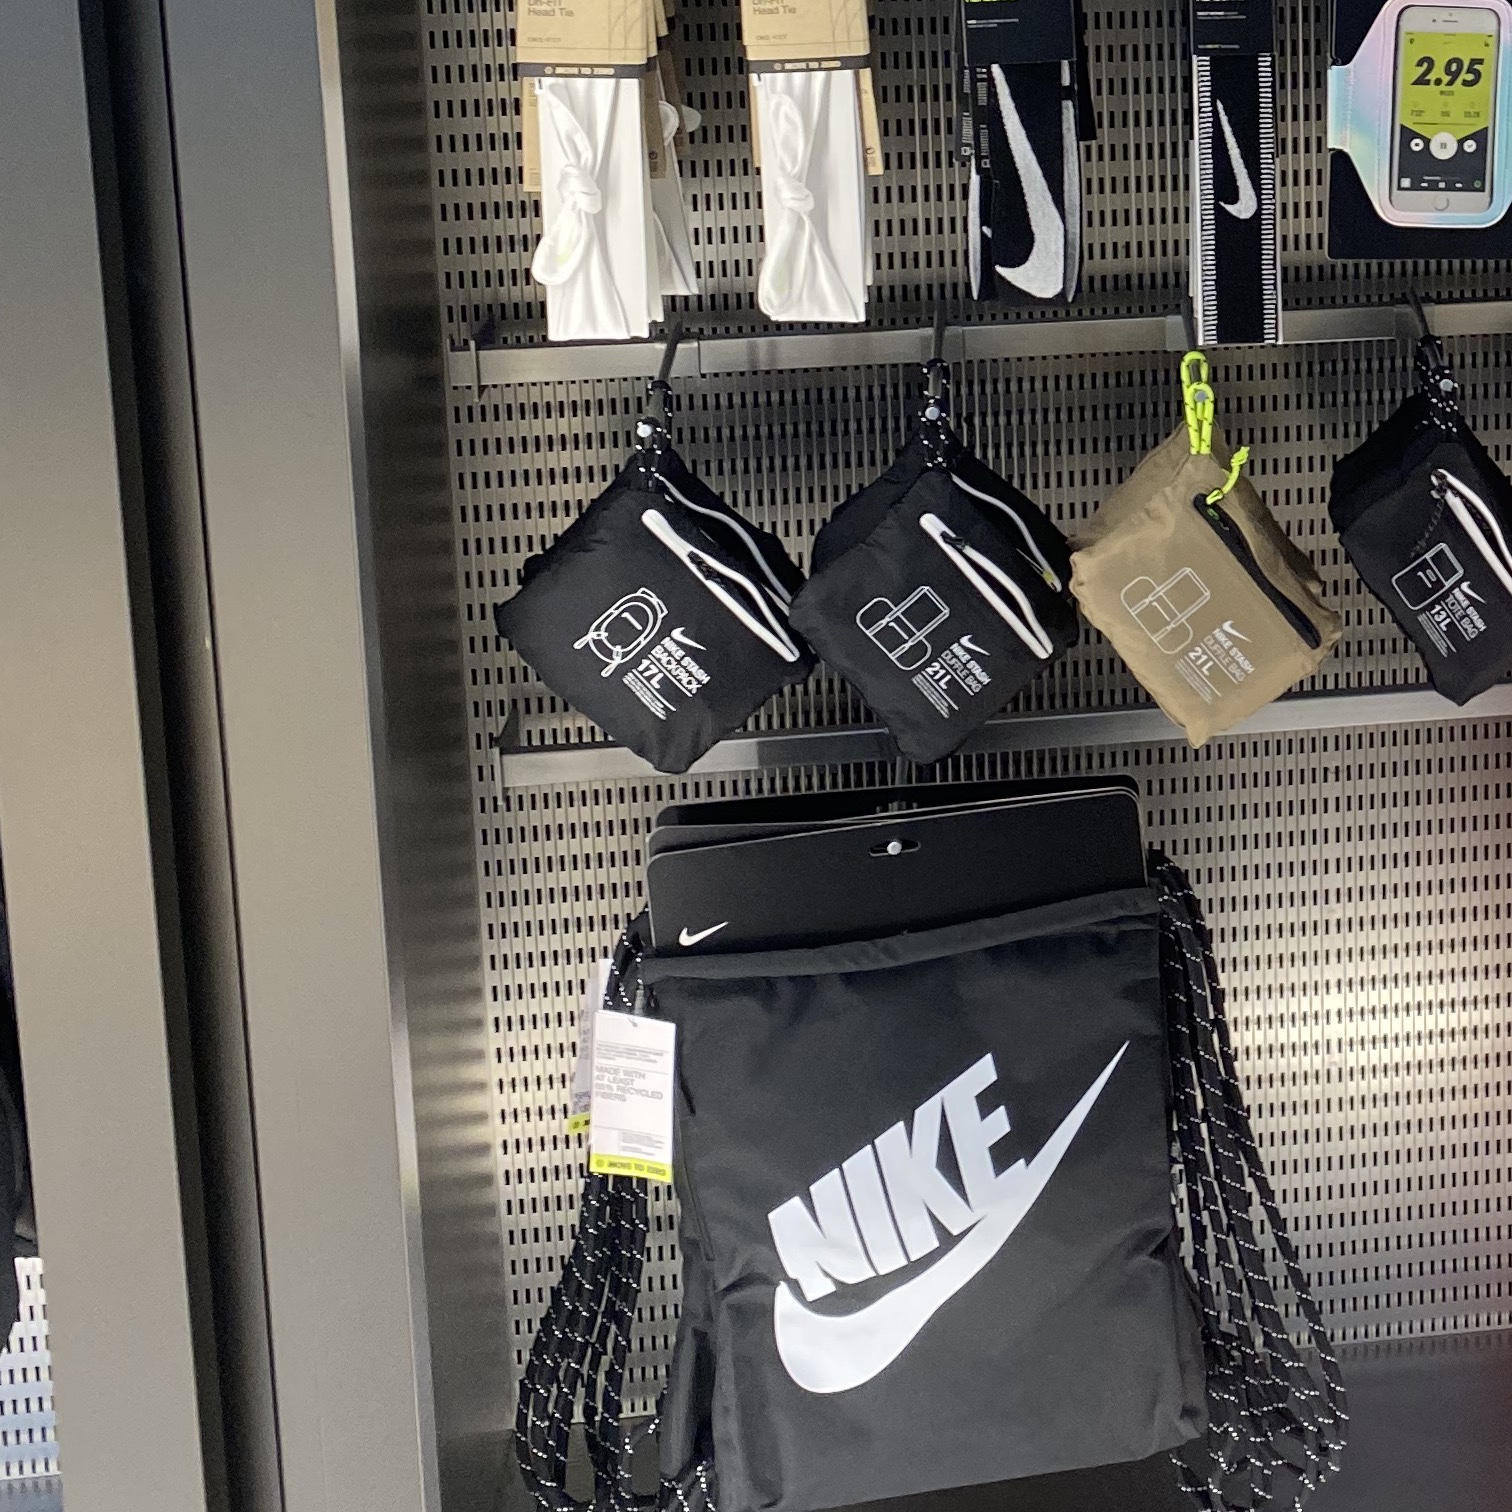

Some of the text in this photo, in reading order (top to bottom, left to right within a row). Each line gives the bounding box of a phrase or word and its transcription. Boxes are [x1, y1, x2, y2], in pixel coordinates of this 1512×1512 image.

[528, 8, 575, 17] Head Tie
[753, 5, 797, 15] Head Tie
[1410, 56, 1485, 87] 2.95
[1431, 604, 1451, 631] 13L
[637, 659, 664, 688] 17L
[651, 645, 702, 694] BACKPACK
[660, 636, 711, 684] NIKE STASH
[768, 1052, 1028, 1301] NIKE
